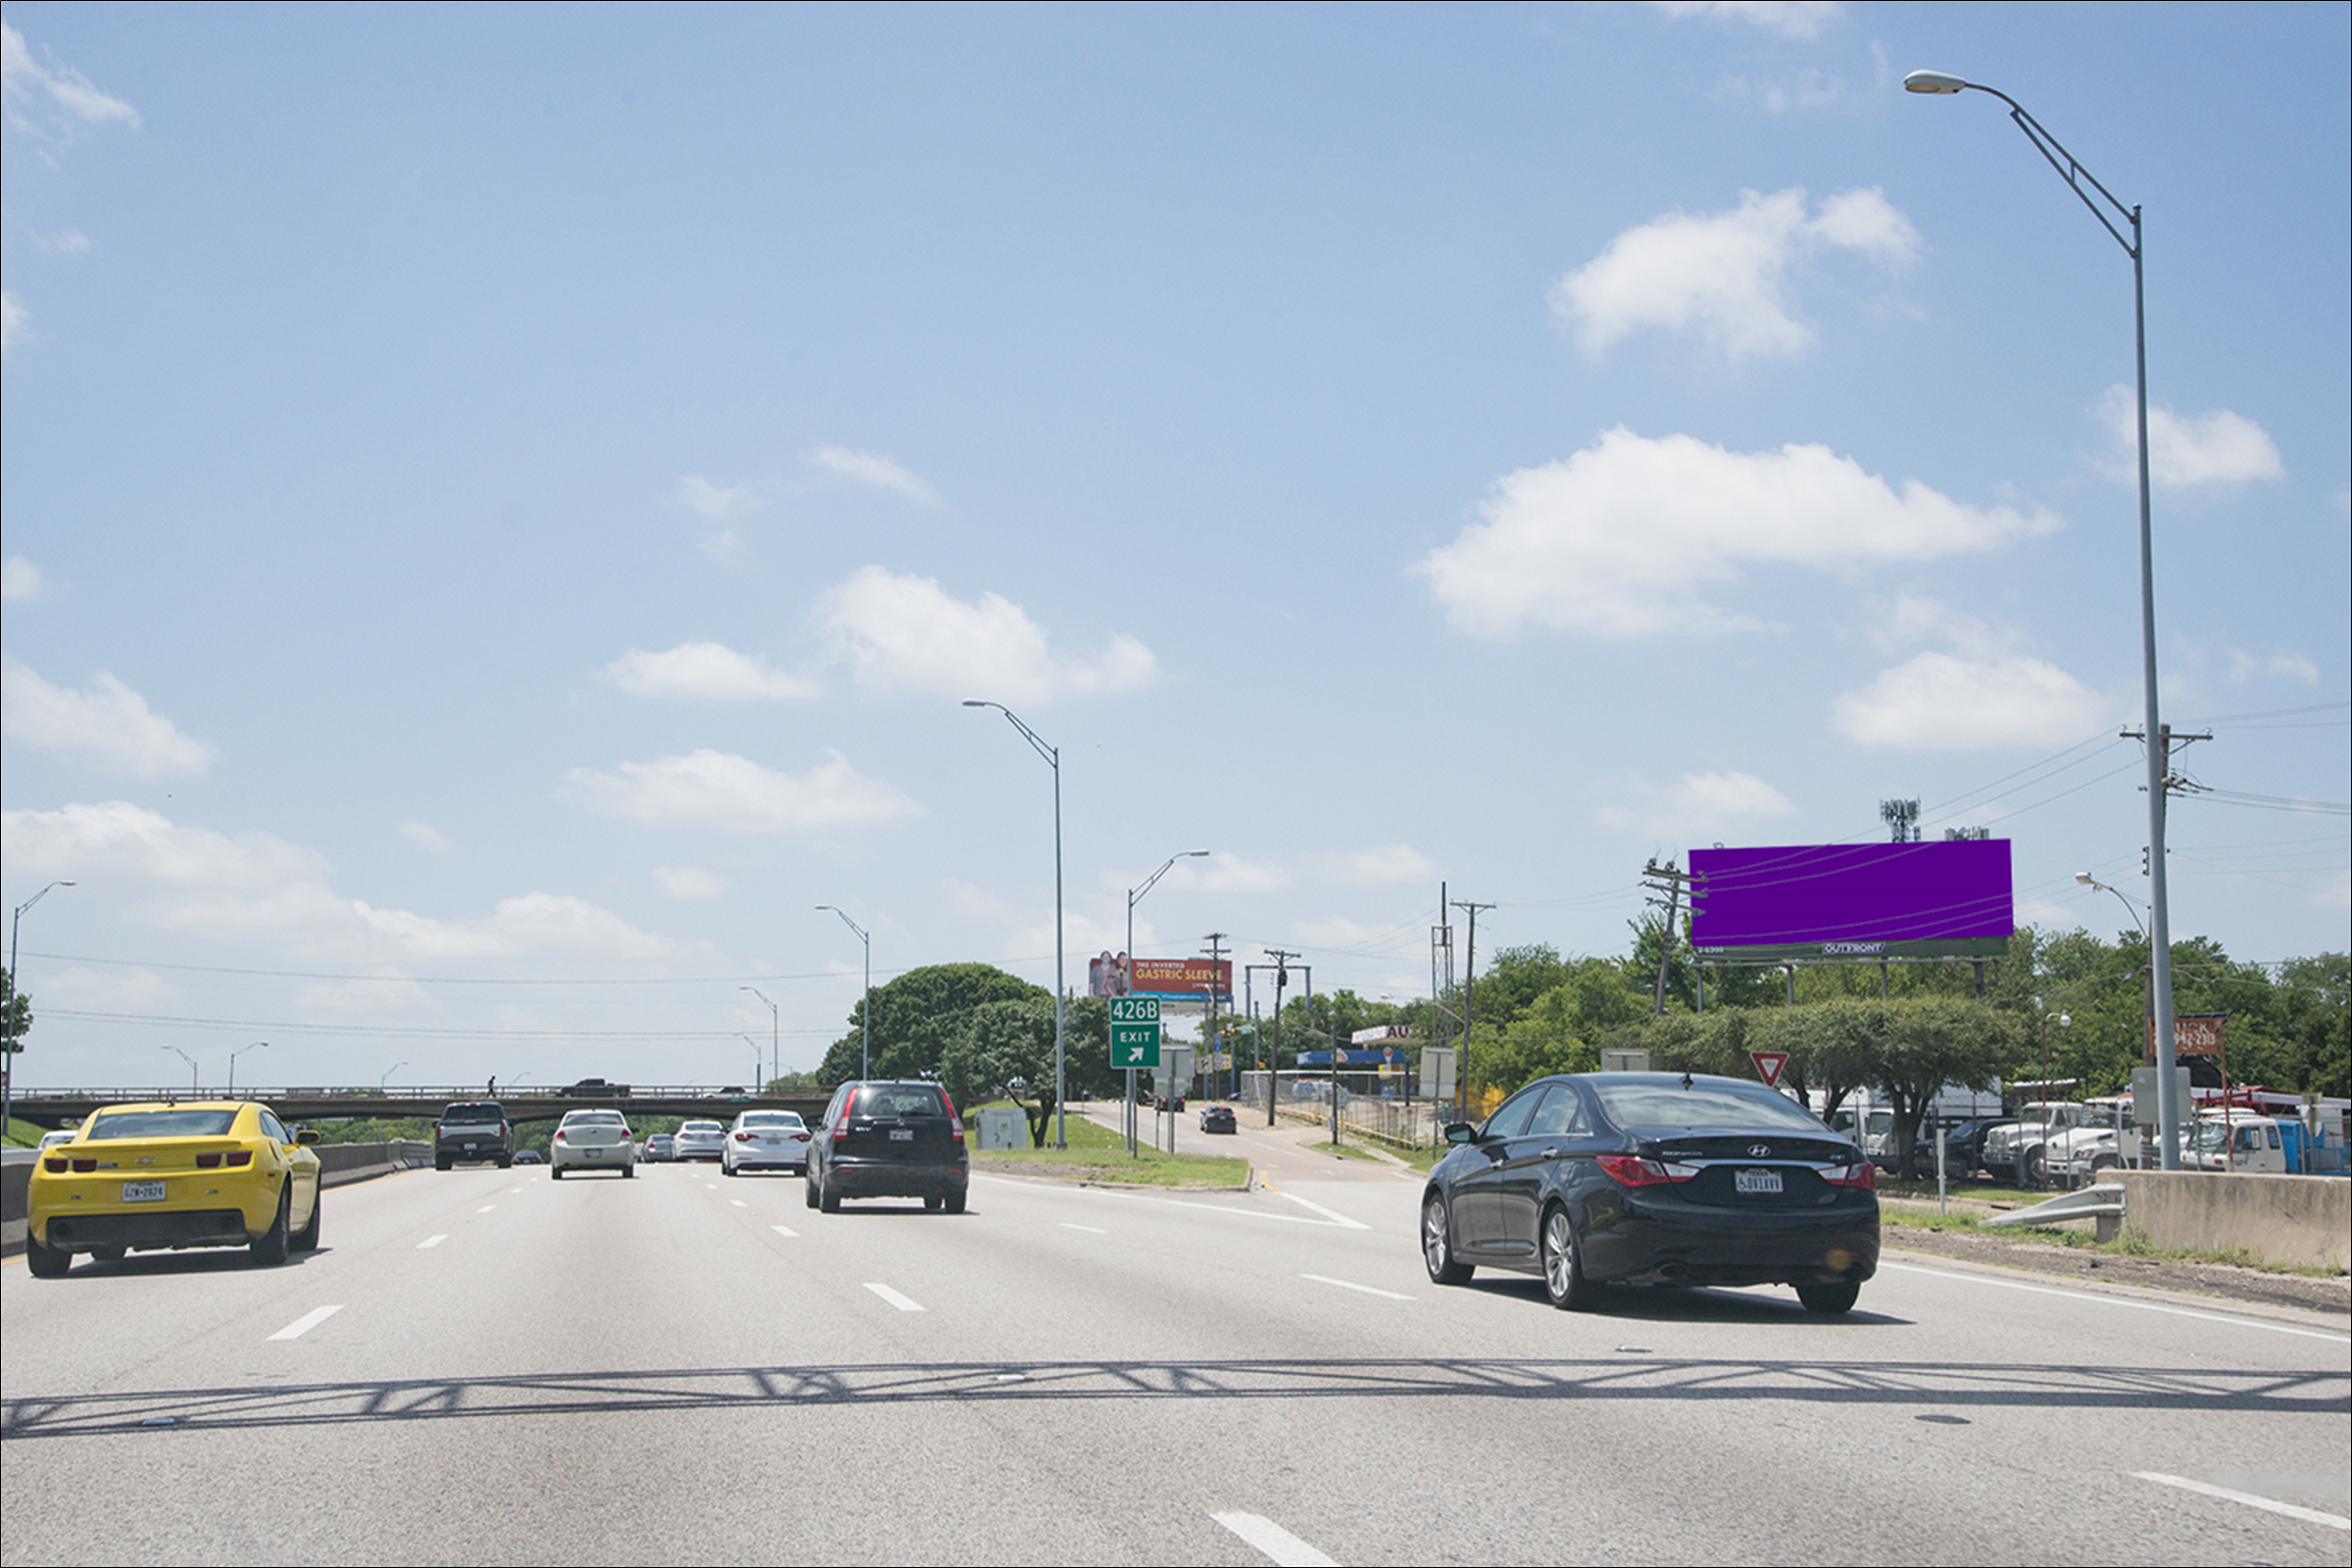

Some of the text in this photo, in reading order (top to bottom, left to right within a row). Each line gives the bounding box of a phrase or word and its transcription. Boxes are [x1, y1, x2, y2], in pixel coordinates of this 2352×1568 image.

[1136, 968, 1223, 981] GASTRIC SLEEVE
[1112, 1001, 1158, 1020] 426B
[1119, 1031, 1152, 1043] EXIT
